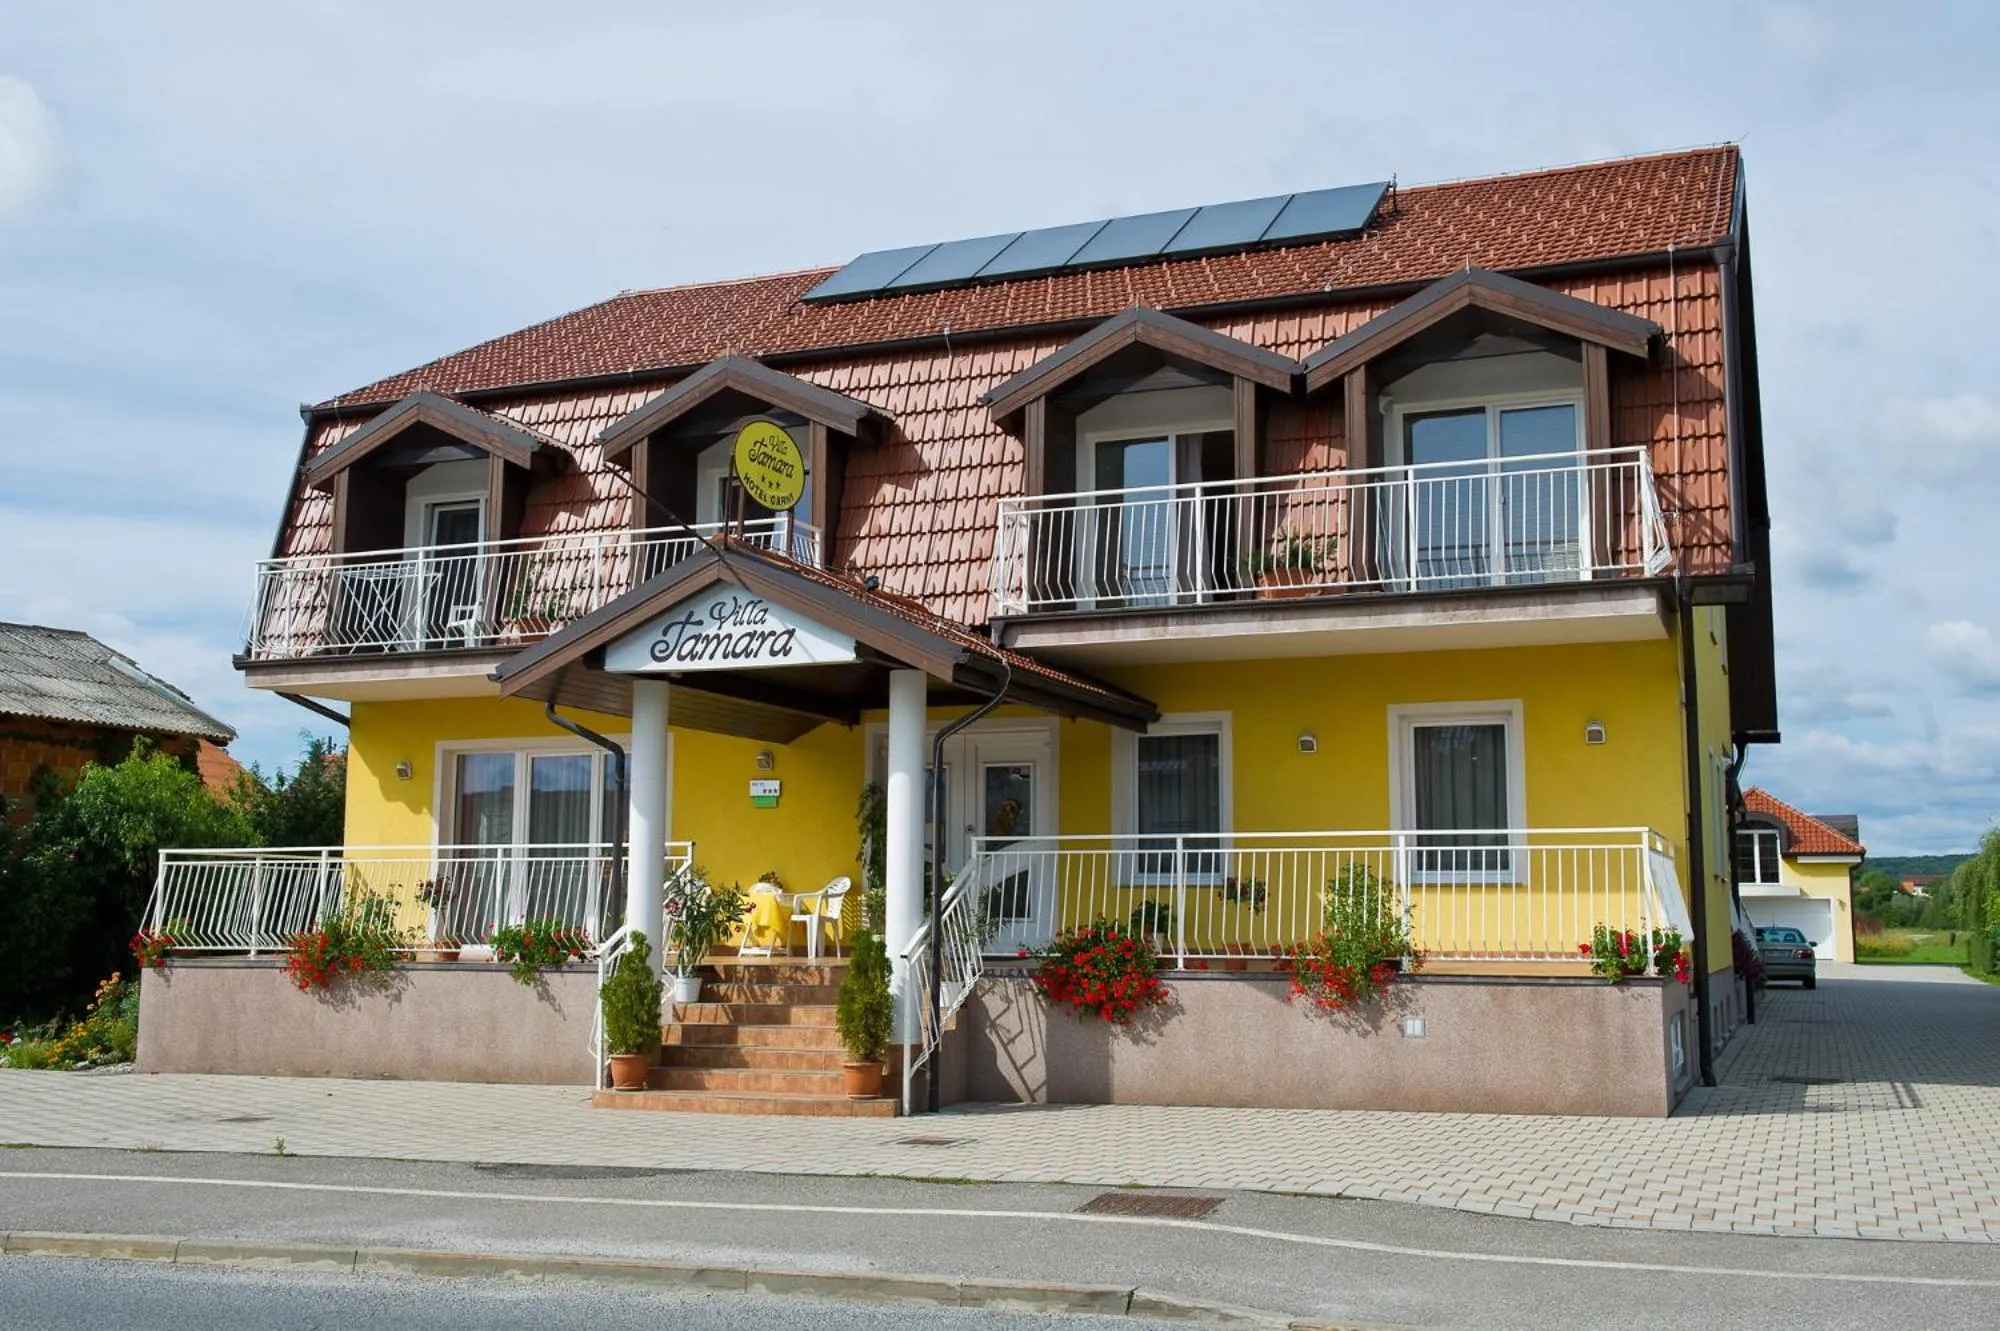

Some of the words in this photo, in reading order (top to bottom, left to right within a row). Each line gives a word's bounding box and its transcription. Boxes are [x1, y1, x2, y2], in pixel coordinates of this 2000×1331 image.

[748, 437, 795, 479] Tamara
[743, 472, 768, 502] HOTEL
[709, 596, 769, 630] Villa
[650, 611, 796, 663] Tamara
